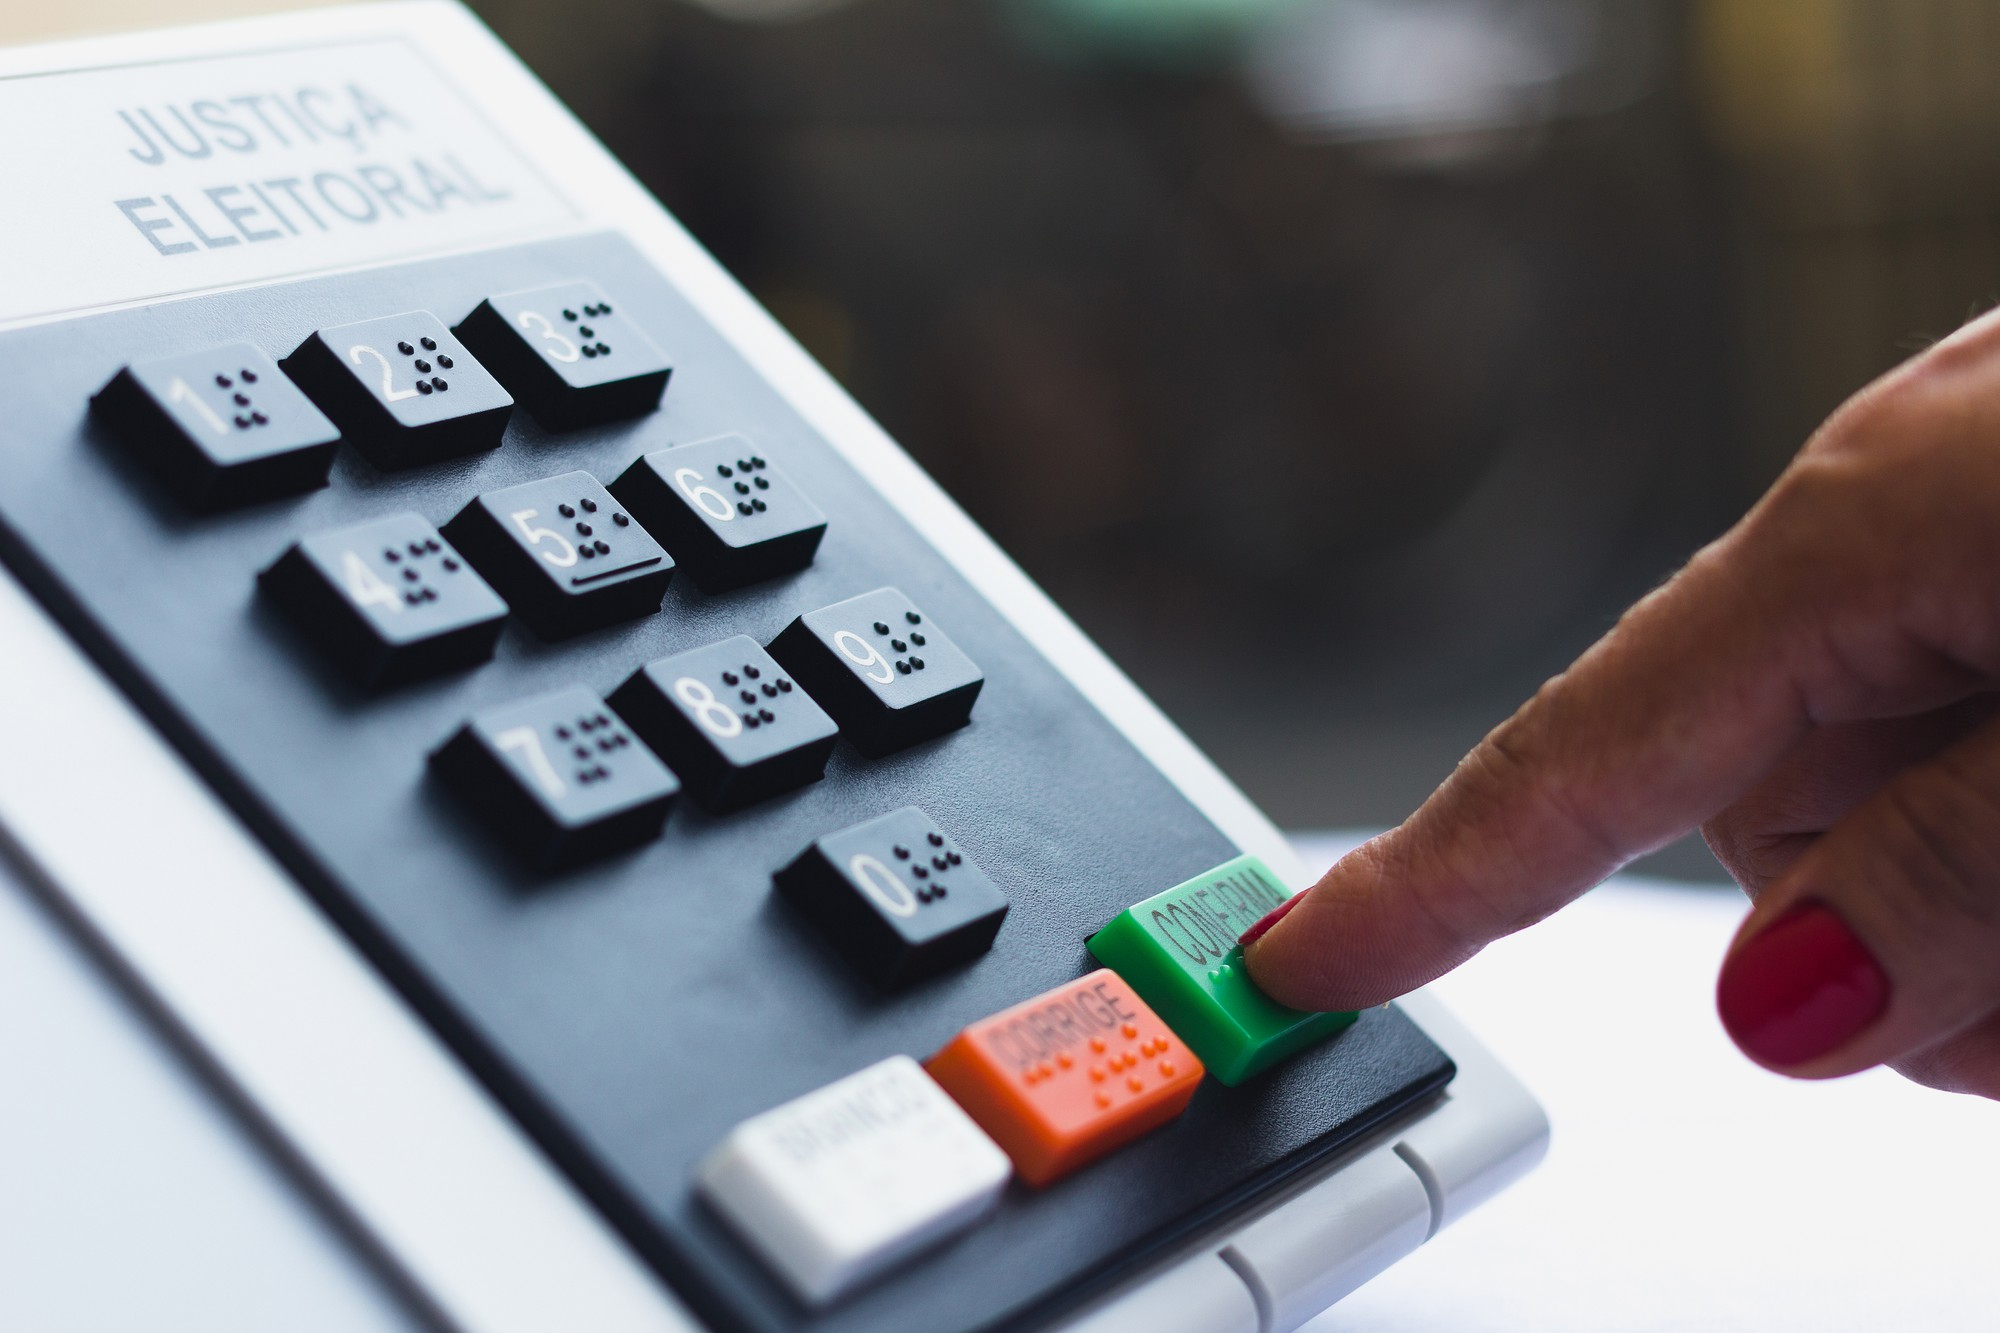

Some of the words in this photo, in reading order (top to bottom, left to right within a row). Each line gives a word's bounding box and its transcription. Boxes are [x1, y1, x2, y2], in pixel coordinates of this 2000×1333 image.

[117, 83, 408, 166] JUSTIÇA
[115, 152, 511, 256] ELEITORAL
[517, 310, 580, 364] 3
[348, 344, 421, 402] 2
[168, 377, 229, 435] 1
[674, 468, 735, 521] 6
[510, 509, 578, 568] 5
[341, 551, 403, 612] 4
[834, 631, 894, 684] 9
[674, 677, 742, 739] 8
[496, 726, 566, 797] 7
[850, 854, 917, 917] 0
[987, 982, 1136, 1073] CORRIGE
